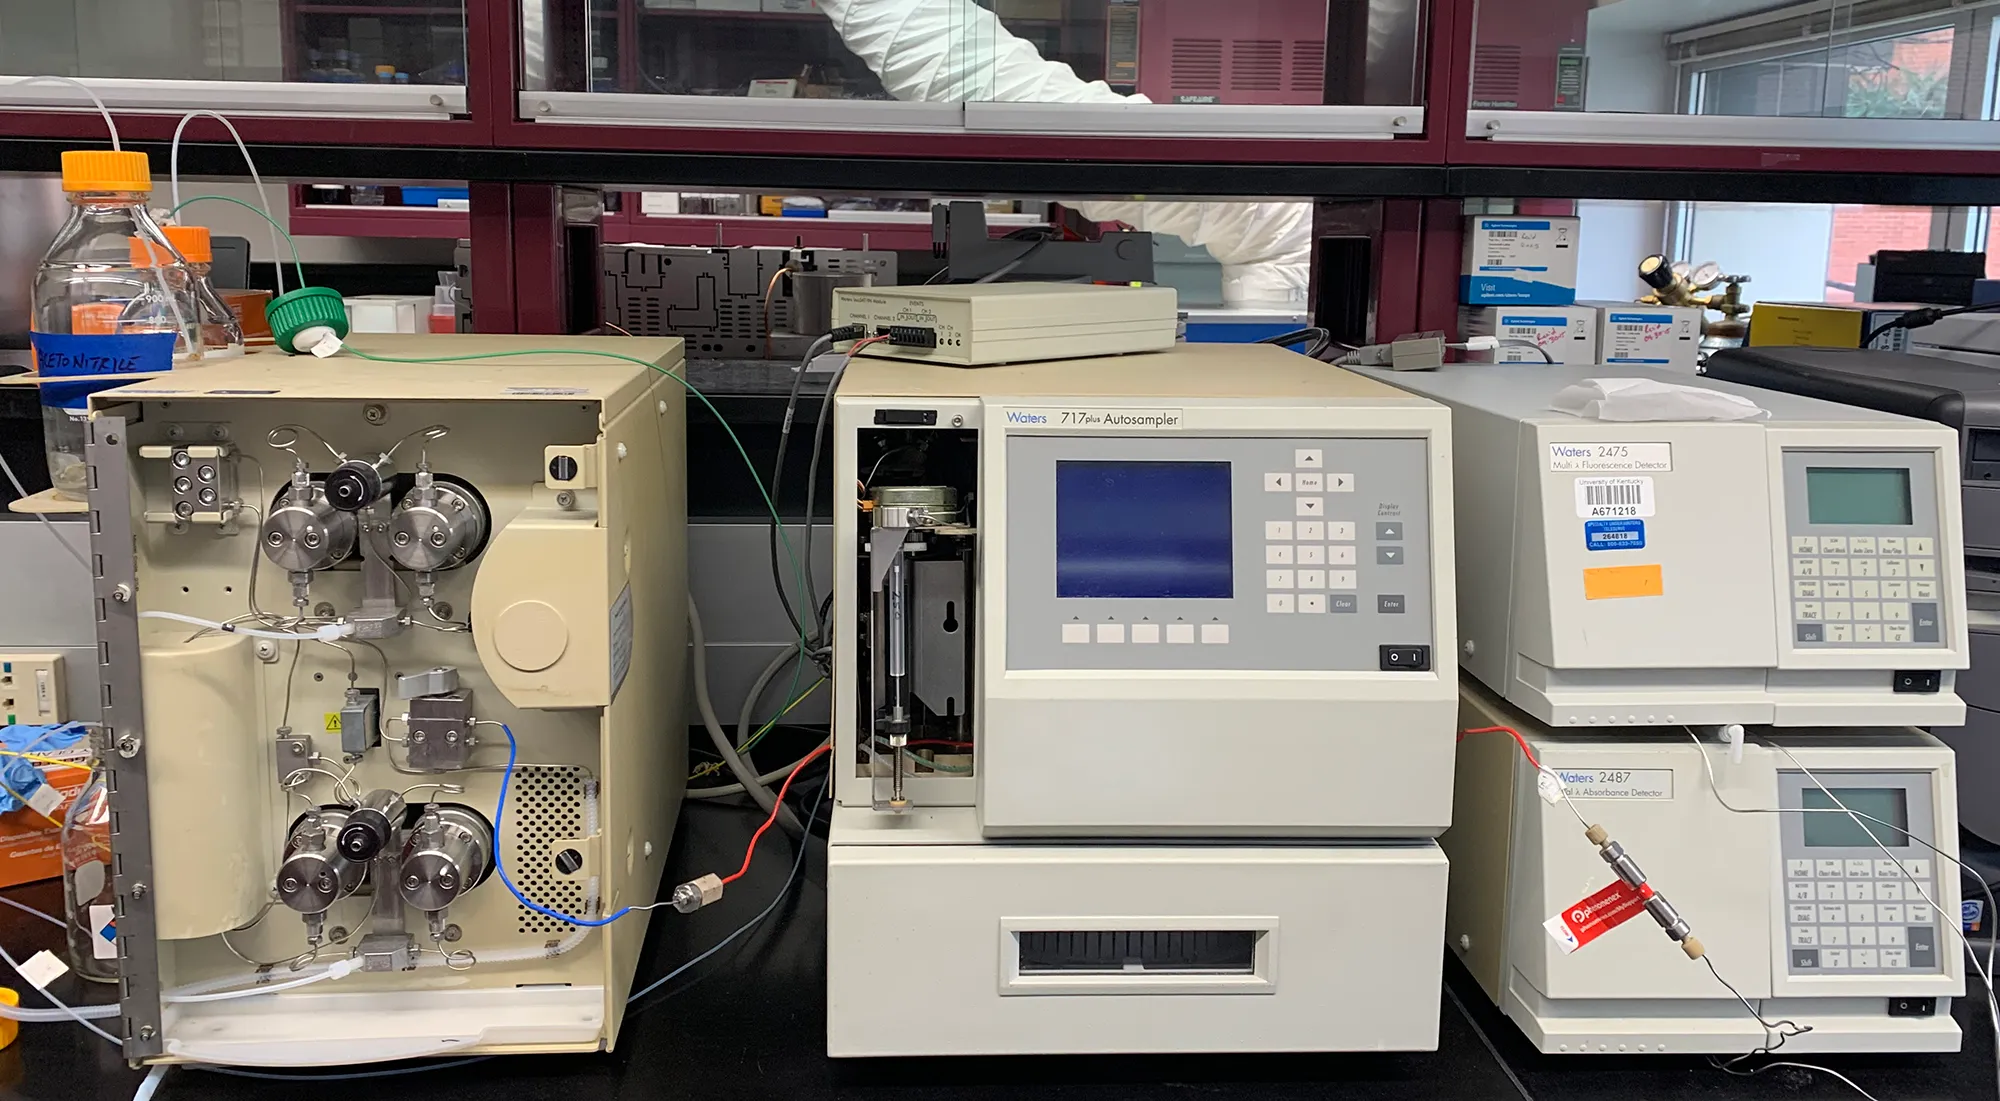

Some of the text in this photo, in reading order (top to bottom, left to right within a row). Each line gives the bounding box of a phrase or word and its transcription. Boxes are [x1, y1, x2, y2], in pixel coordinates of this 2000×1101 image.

[1481, 283, 1496, 292] Visit
[1006, 411, 1048, 424] Waters
[1103, 413, 1179, 429] Autosampler
[1552, 446, 1629, 458] Waters 2475
[1552, 459, 1573, 469] Multi
[1581, 460, 1633, 470] Fluorescence
[1634, 461, 1668, 470] Detector
[1616, 478, 1644, 486] Kentucky
[1378, 502, 1399, 511] Display
[1591, 506, 1637, 517] A671218
[1919, 618, 1933, 626] Enter
[1599, 771, 1632, 784] 2487
[1583, 788, 1629, 797] Absorbance
[1631, 789, 1663, 797] Detector
[1583, 891, 1622, 919] phenomenex
[1915, 943, 1929, 951] Enter
